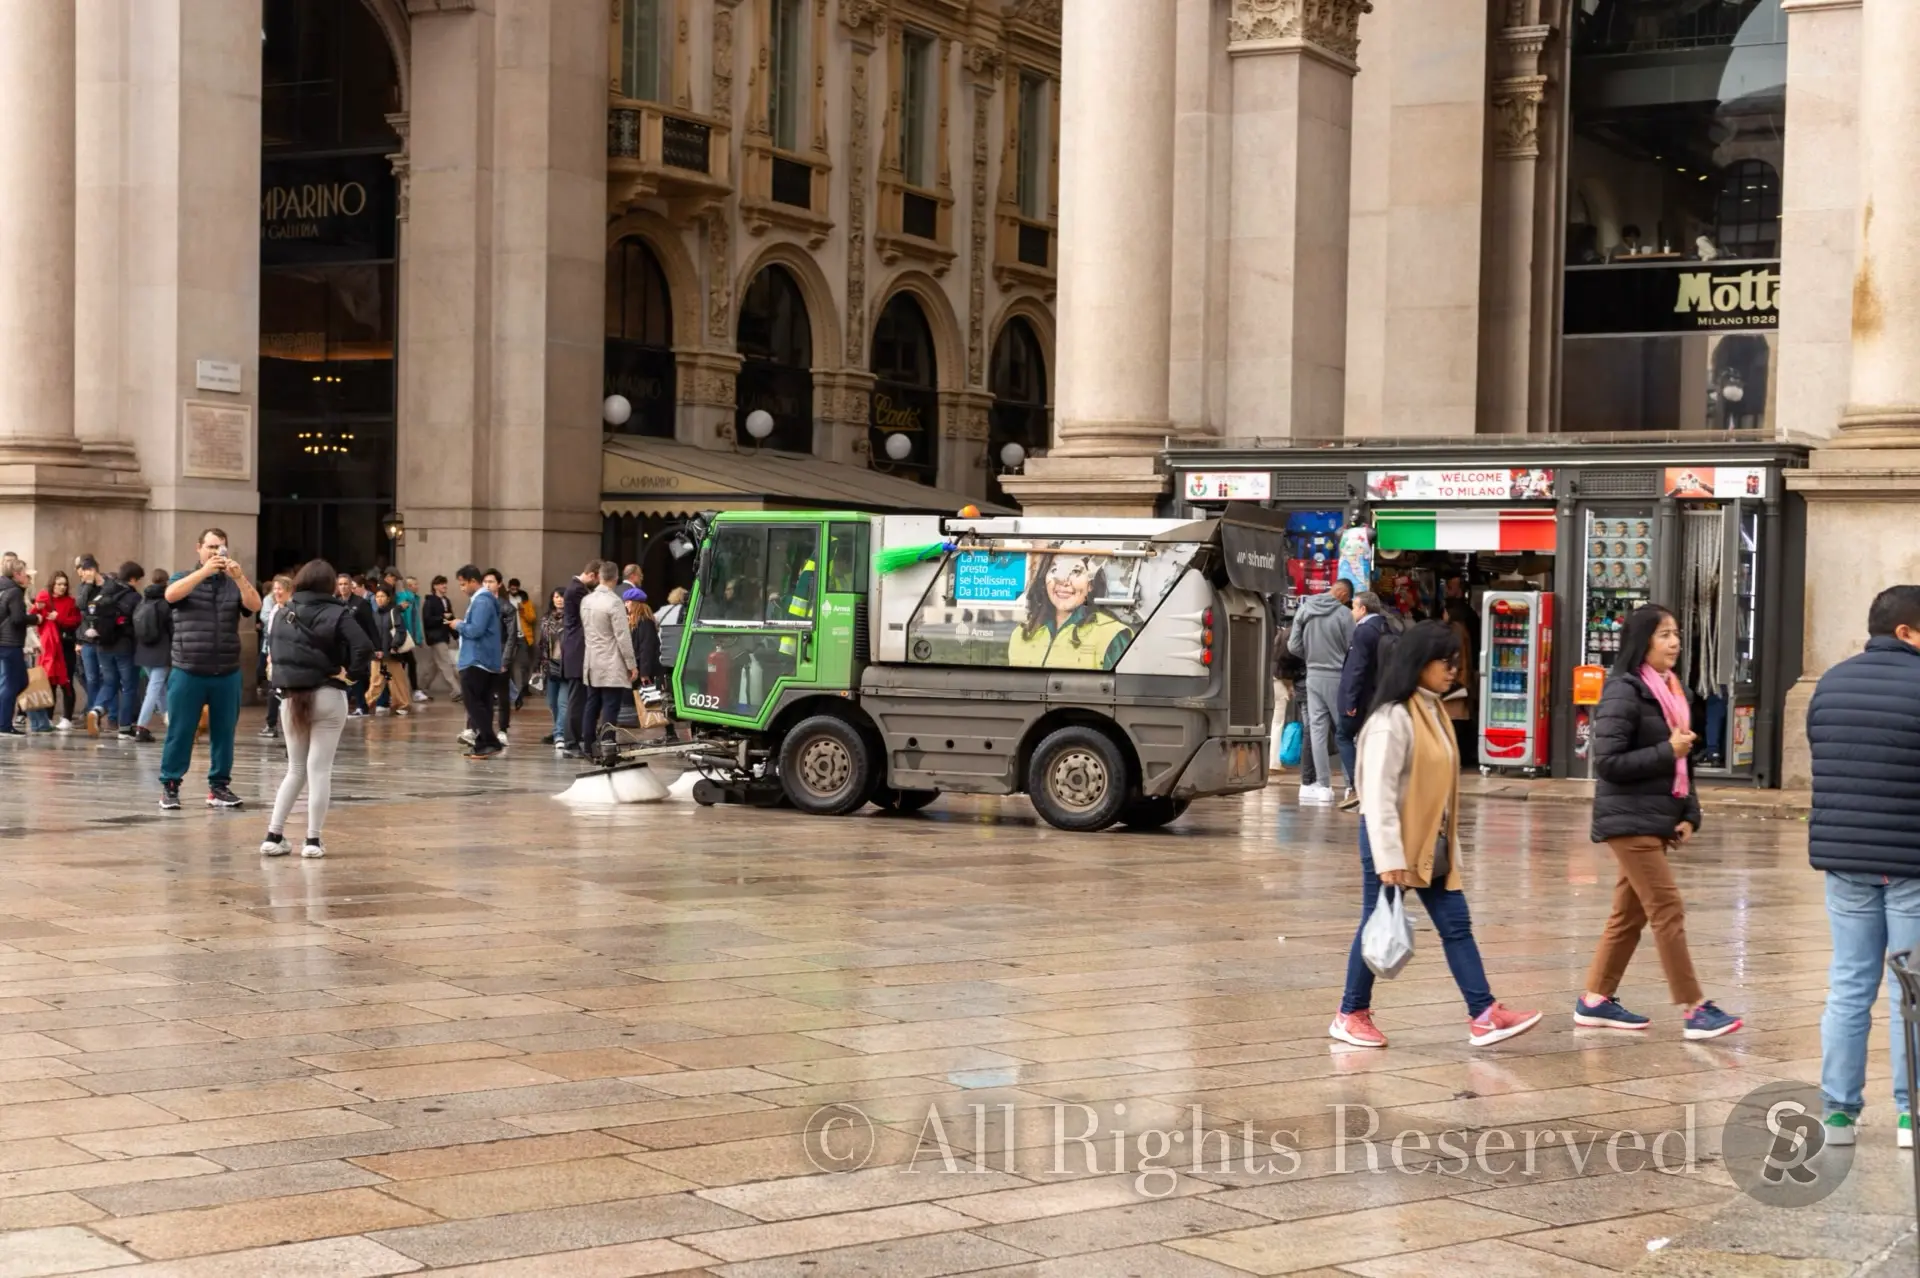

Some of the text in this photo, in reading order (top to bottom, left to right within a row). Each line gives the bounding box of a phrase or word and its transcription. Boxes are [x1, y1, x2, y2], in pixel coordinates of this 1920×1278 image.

[1697, 315, 1777, 326] MILANO 1928
[620, 475, 679, 490] CAMPARINO
[1441, 472, 1503, 482] WELCOME
[1438, 487, 1454, 496] TO
[1457, 487, 1506, 497] MILANO
[961, 553, 972, 563] La
[960, 564, 989, 576] presto
[960, 575, 1018, 587] sei bellissima.
[960, 586, 971, 597] Da
[975, 587, 990, 597] 110
[971, 628, 994, 637] Amsa
[689, 692, 720, 709] 6032
